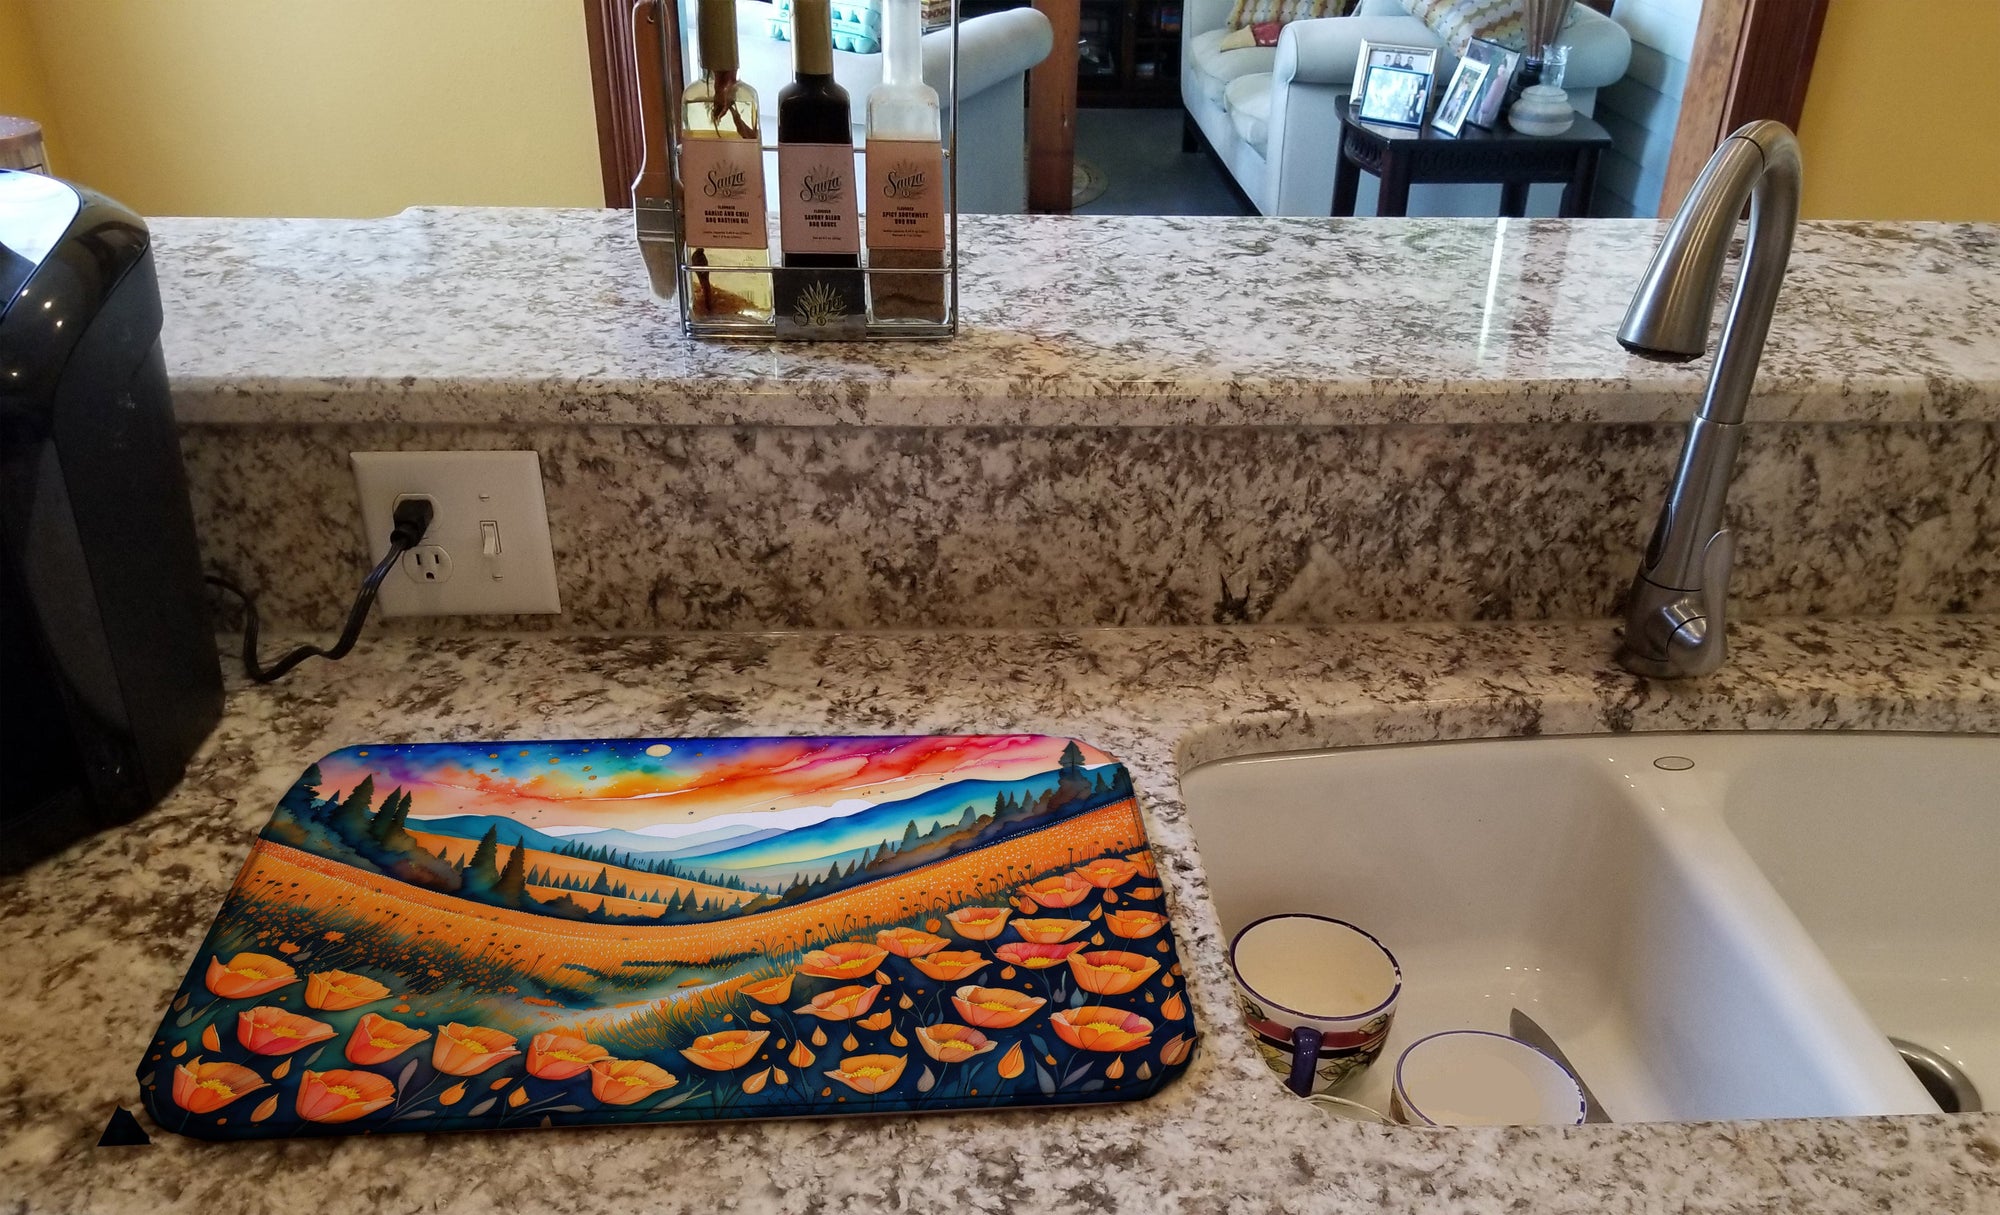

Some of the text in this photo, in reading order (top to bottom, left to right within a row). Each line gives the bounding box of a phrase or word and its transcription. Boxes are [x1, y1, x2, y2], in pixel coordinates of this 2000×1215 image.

[704, 170, 745, 198] Sauza
[800, 175, 841, 203] Sauza
[884, 171, 925, 199] Sauza
